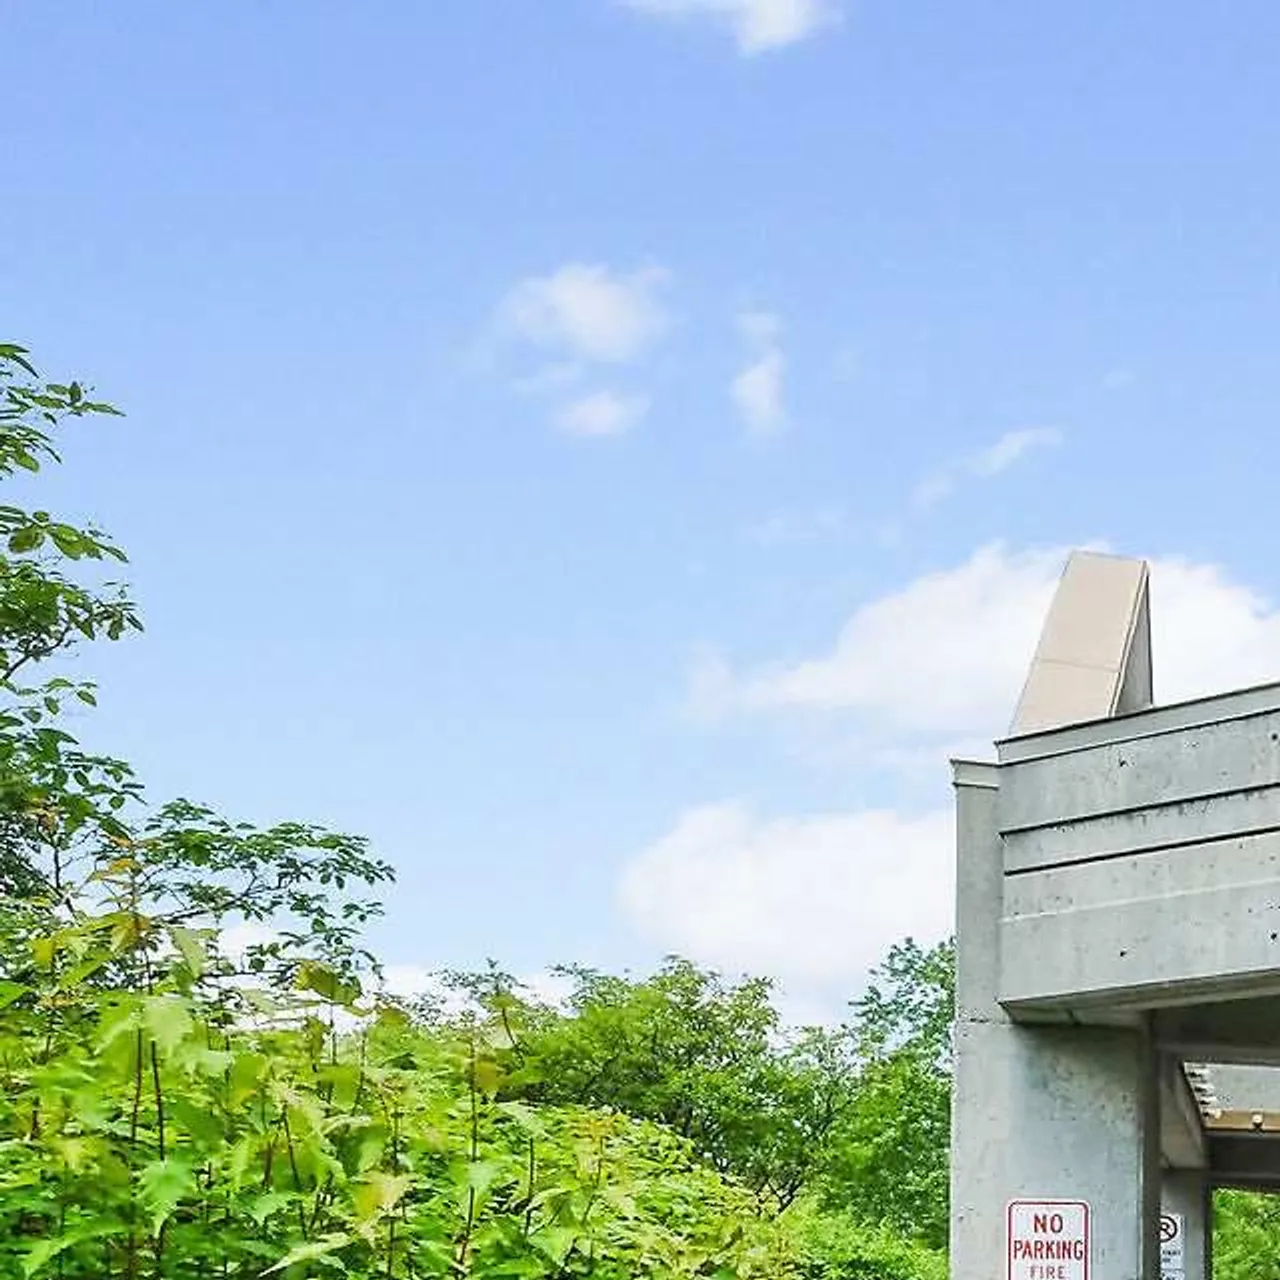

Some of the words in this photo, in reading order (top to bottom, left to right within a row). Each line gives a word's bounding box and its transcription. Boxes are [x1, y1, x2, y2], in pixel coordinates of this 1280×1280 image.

[1033, 1213, 1063, 1234] NO
[1013, 1240, 1083, 1261] PARKING
[1029, 1265, 1065, 1279] FIRE
